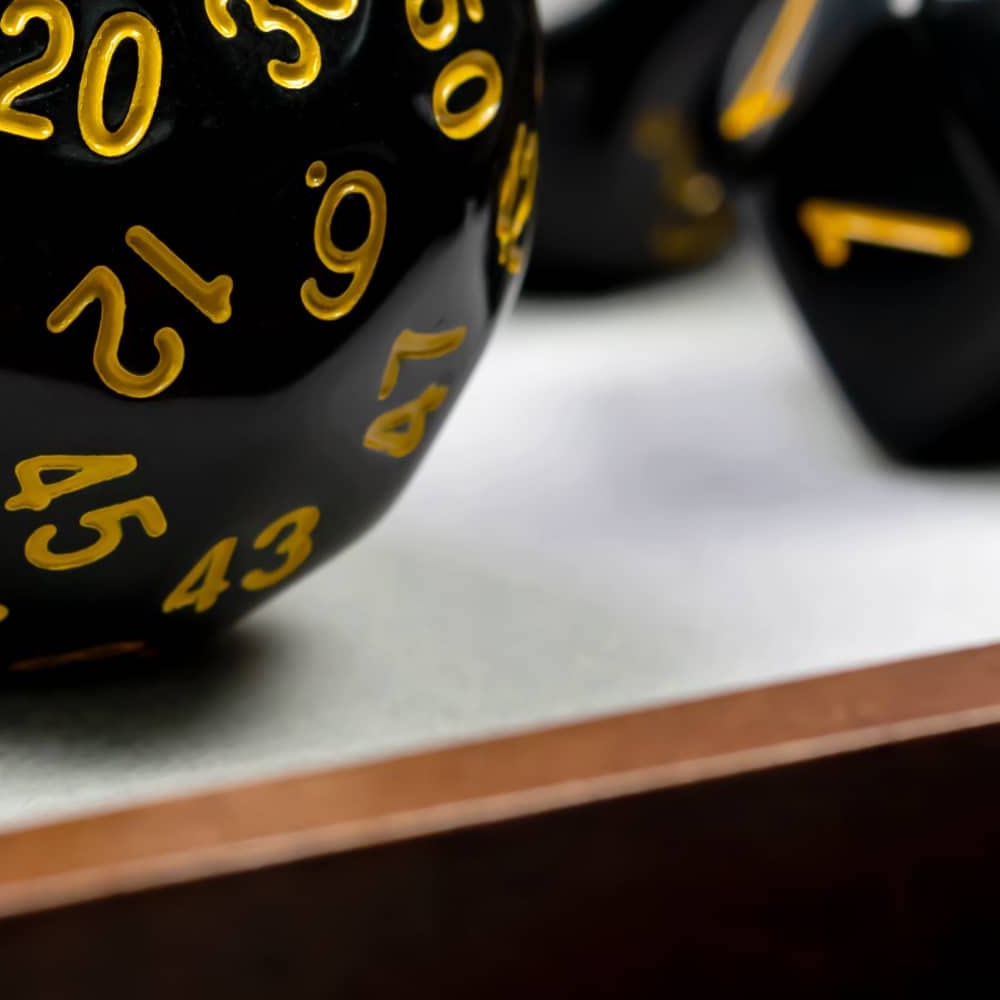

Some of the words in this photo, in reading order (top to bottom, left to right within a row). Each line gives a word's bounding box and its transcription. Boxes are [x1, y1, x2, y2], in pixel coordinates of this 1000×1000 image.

[46, 224, 234, 399] 12
[362, 326, 468, 459] 47
[4, 453, 168, 571] 45
[161, 505, 321, 613] 43
